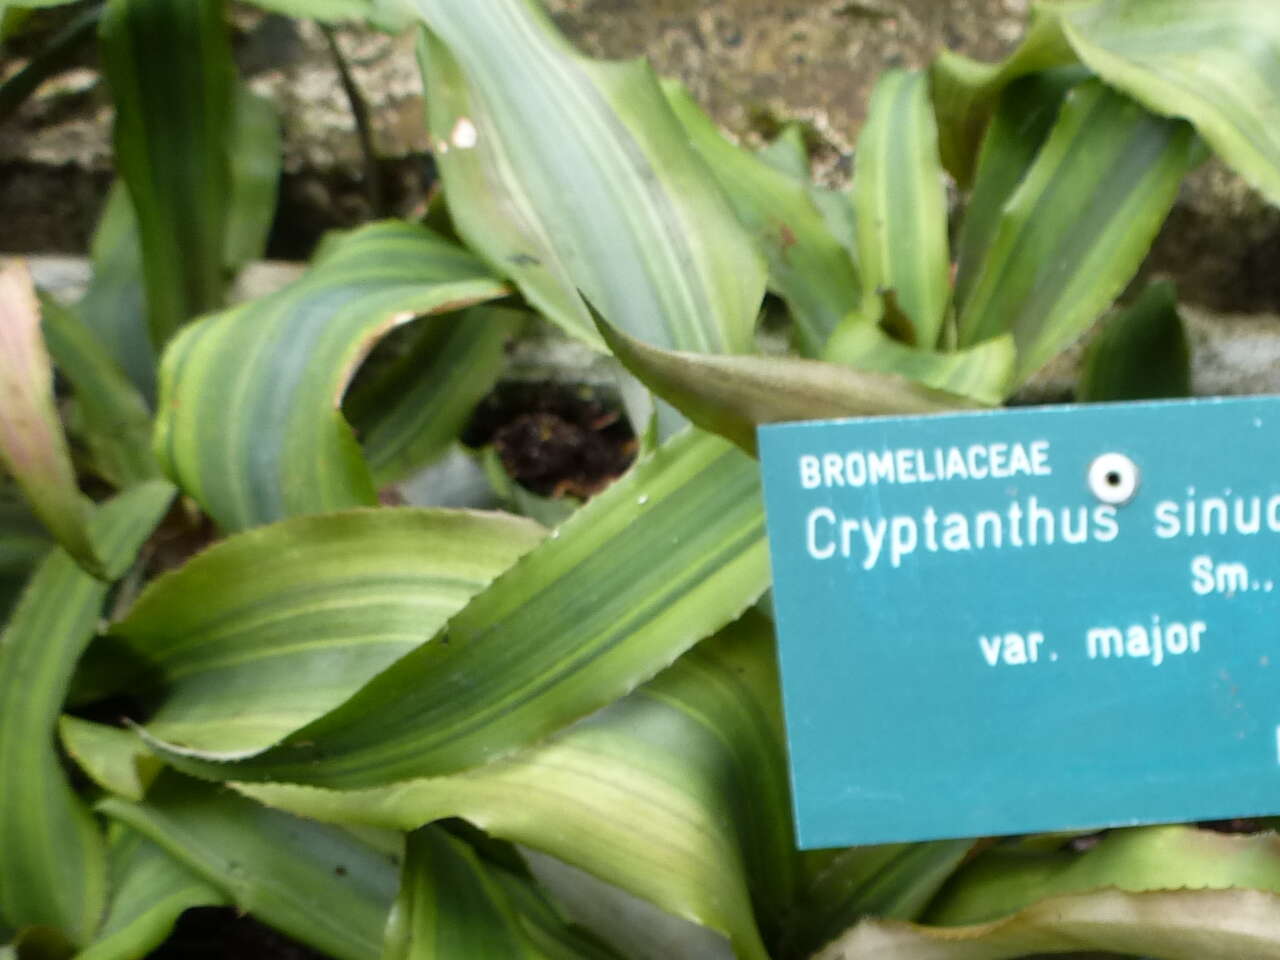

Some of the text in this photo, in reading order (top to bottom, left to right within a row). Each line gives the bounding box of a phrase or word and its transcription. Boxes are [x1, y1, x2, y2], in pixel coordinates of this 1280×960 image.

[799, 441, 1052, 489] BROMELIACEAE
[805, 497, 1120, 569] Cryptanthus
[978, 613, 1208, 667] var. major
